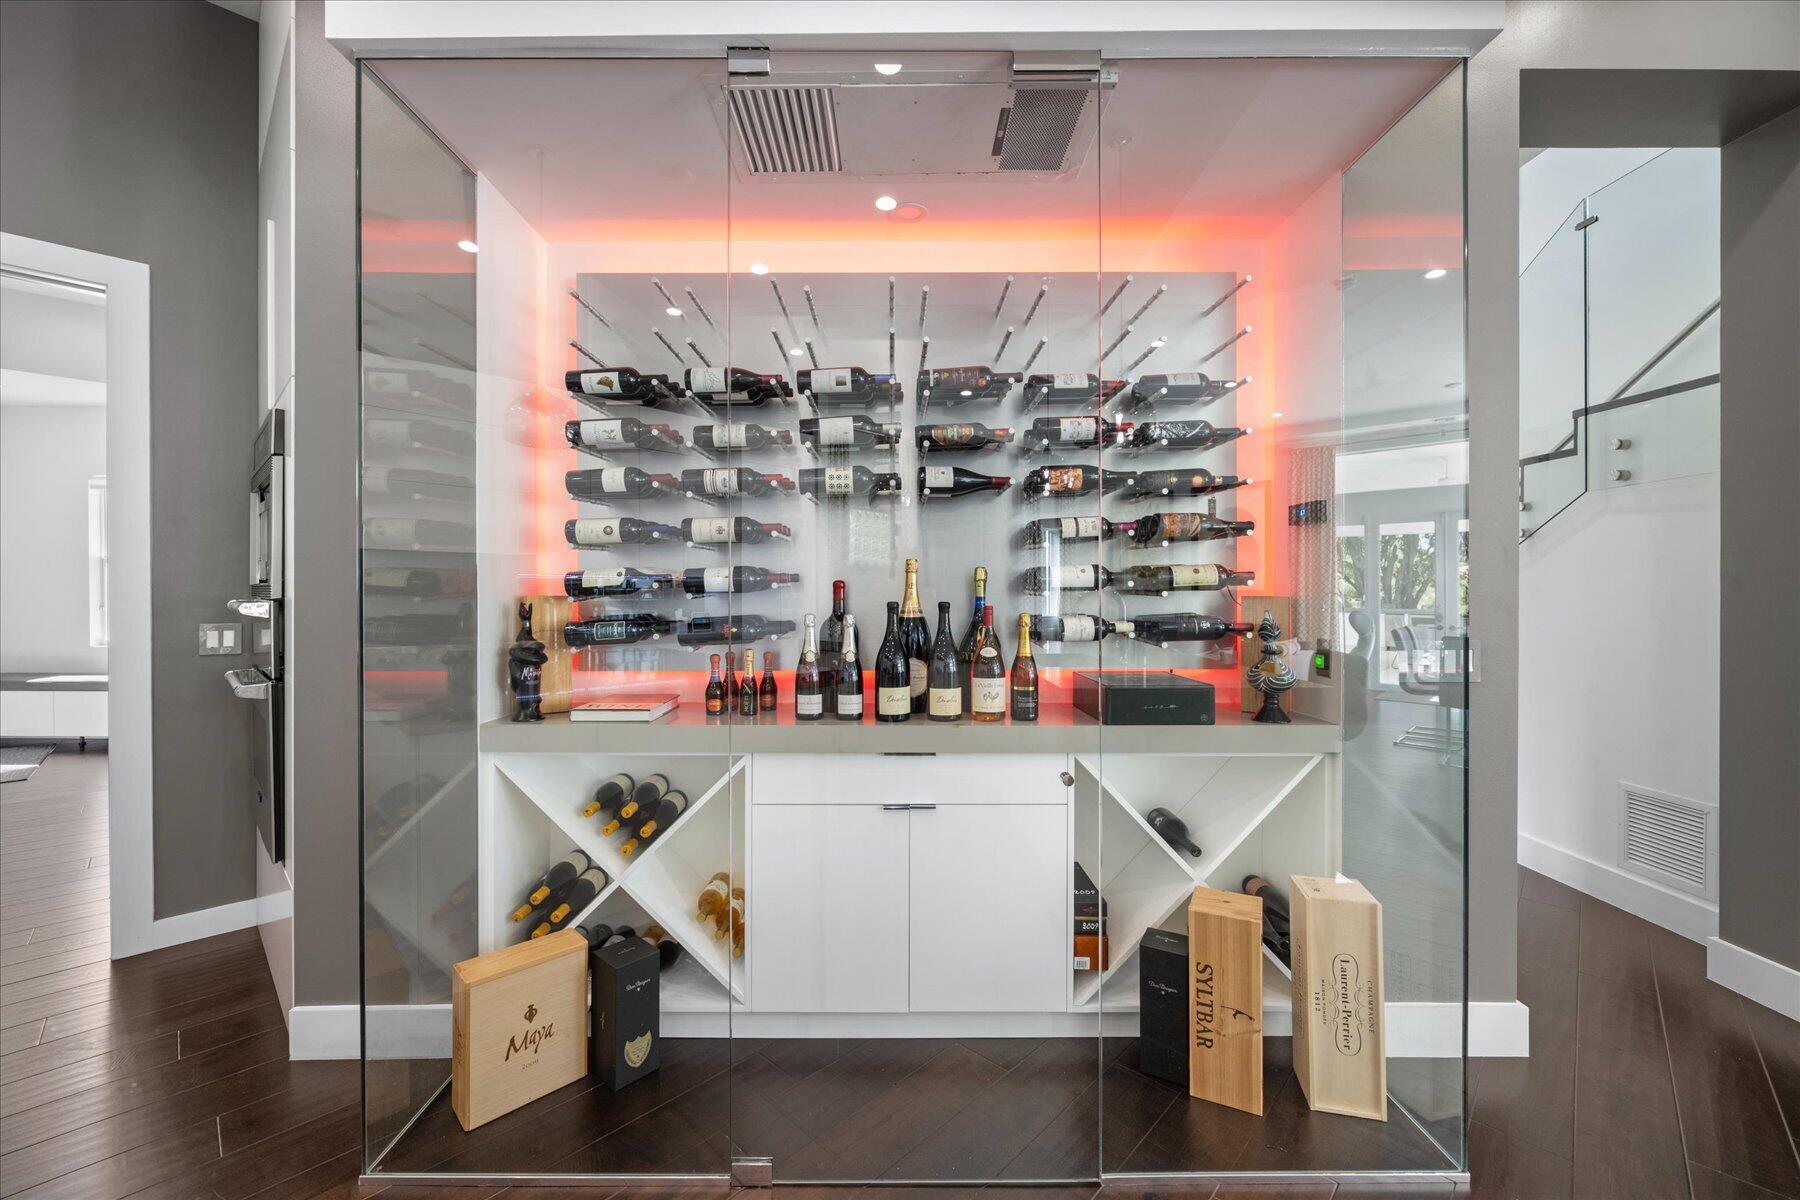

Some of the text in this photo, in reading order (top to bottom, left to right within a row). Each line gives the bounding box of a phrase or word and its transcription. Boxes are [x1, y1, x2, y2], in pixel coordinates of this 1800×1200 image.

[1195, 962, 1214, 1049] SYLTBAR
[1340, 959, 1353, 1051] Laurent-Perrier
[1367, 980, 1376, 1034] CHAMPAGNE
[505, 1022, 556, 1062] Maya
